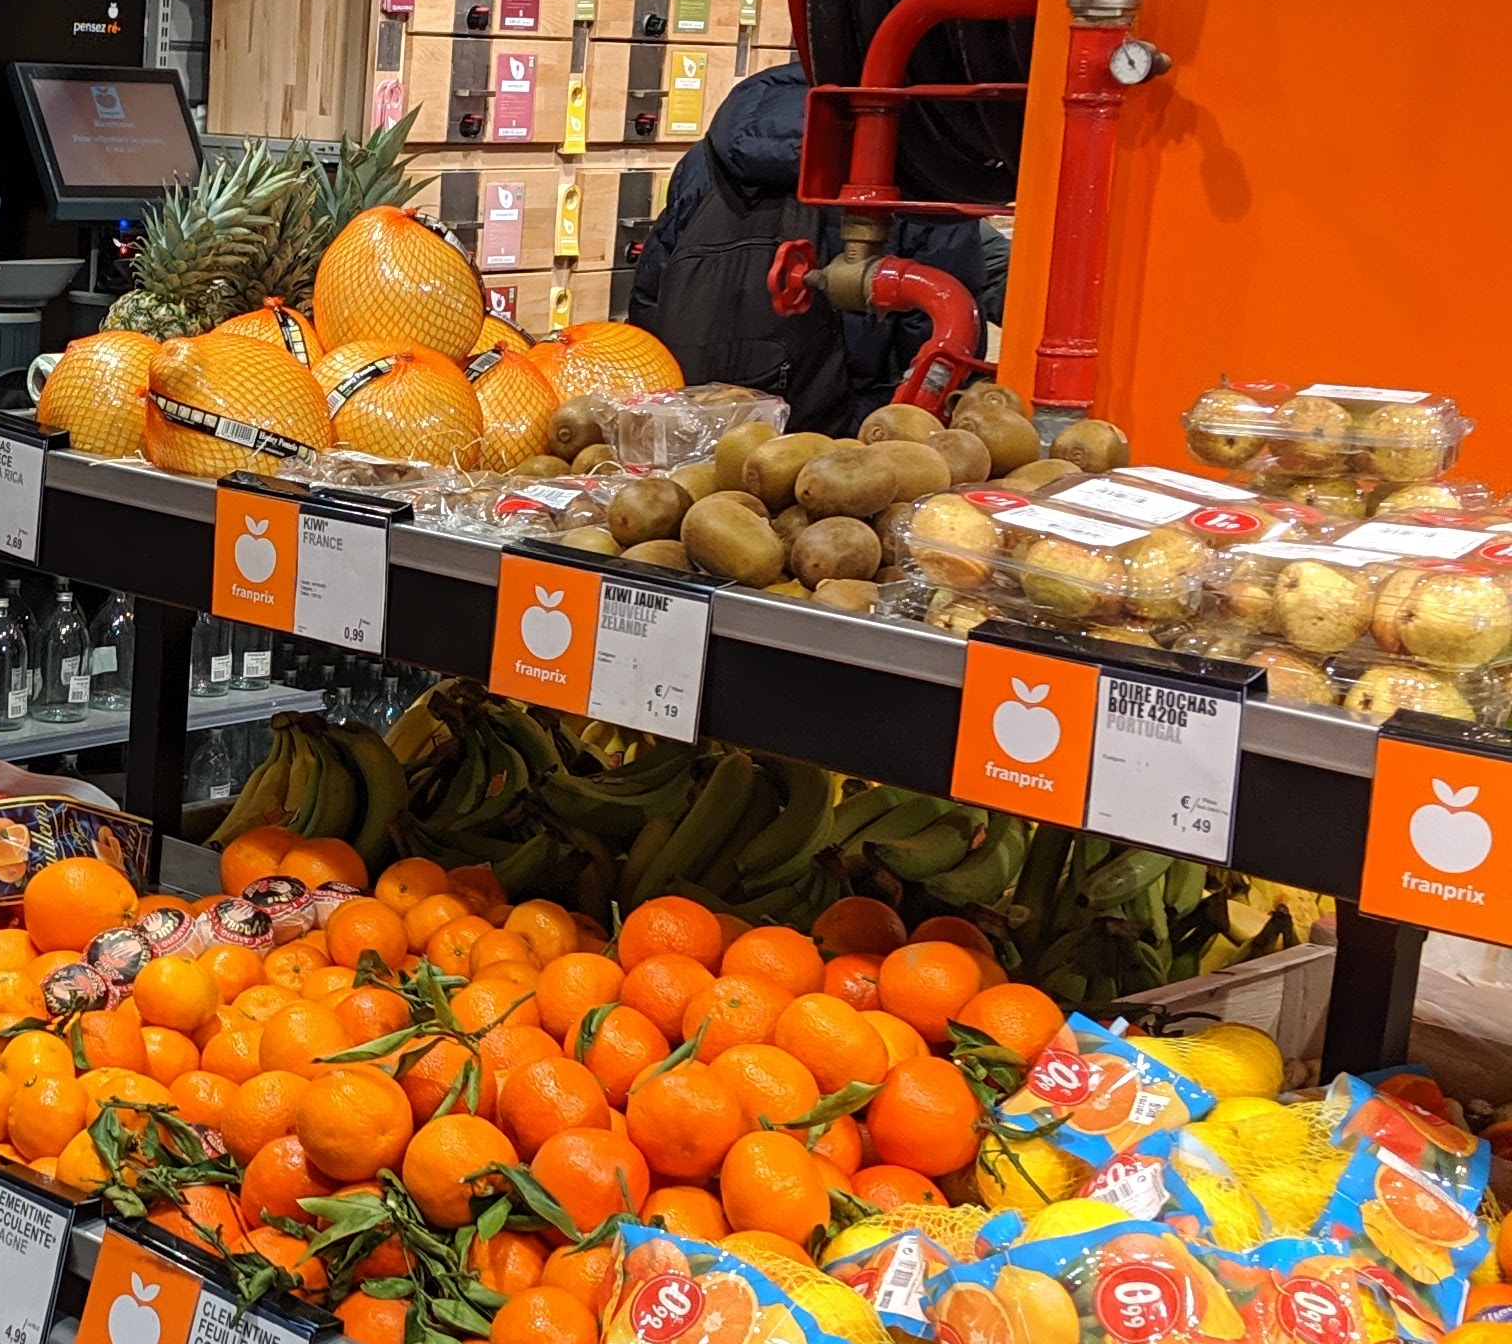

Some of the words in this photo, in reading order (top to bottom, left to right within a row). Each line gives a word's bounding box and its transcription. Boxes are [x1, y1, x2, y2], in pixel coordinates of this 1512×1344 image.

[73, 21, 106, 35] pensez
[4, 470, 24, 486] RICA
[6, 534, 22, 549] 2,69
[302, 532, 343, 551] FRANCE
[231, 583, 275, 605] franprix
[604, 585, 632, 604] KIWI
[602, 601, 657, 625] NOUVELLE
[344, 627, 364, 642] 0,99
[601, 614, 648, 638] ZELANDE
[515, 659, 567, 685] franprix
[1109, 680, 1153, 704] POIRE
[1156, 688, 1218, 716] ROCHAS
[1147, 705, 1188, 728] 420G
[1106, 715, 1183, 745] PORTUGAL
[985, 761, 1054, 792] franprix
[1401, 871, 1485, 905] franprix
